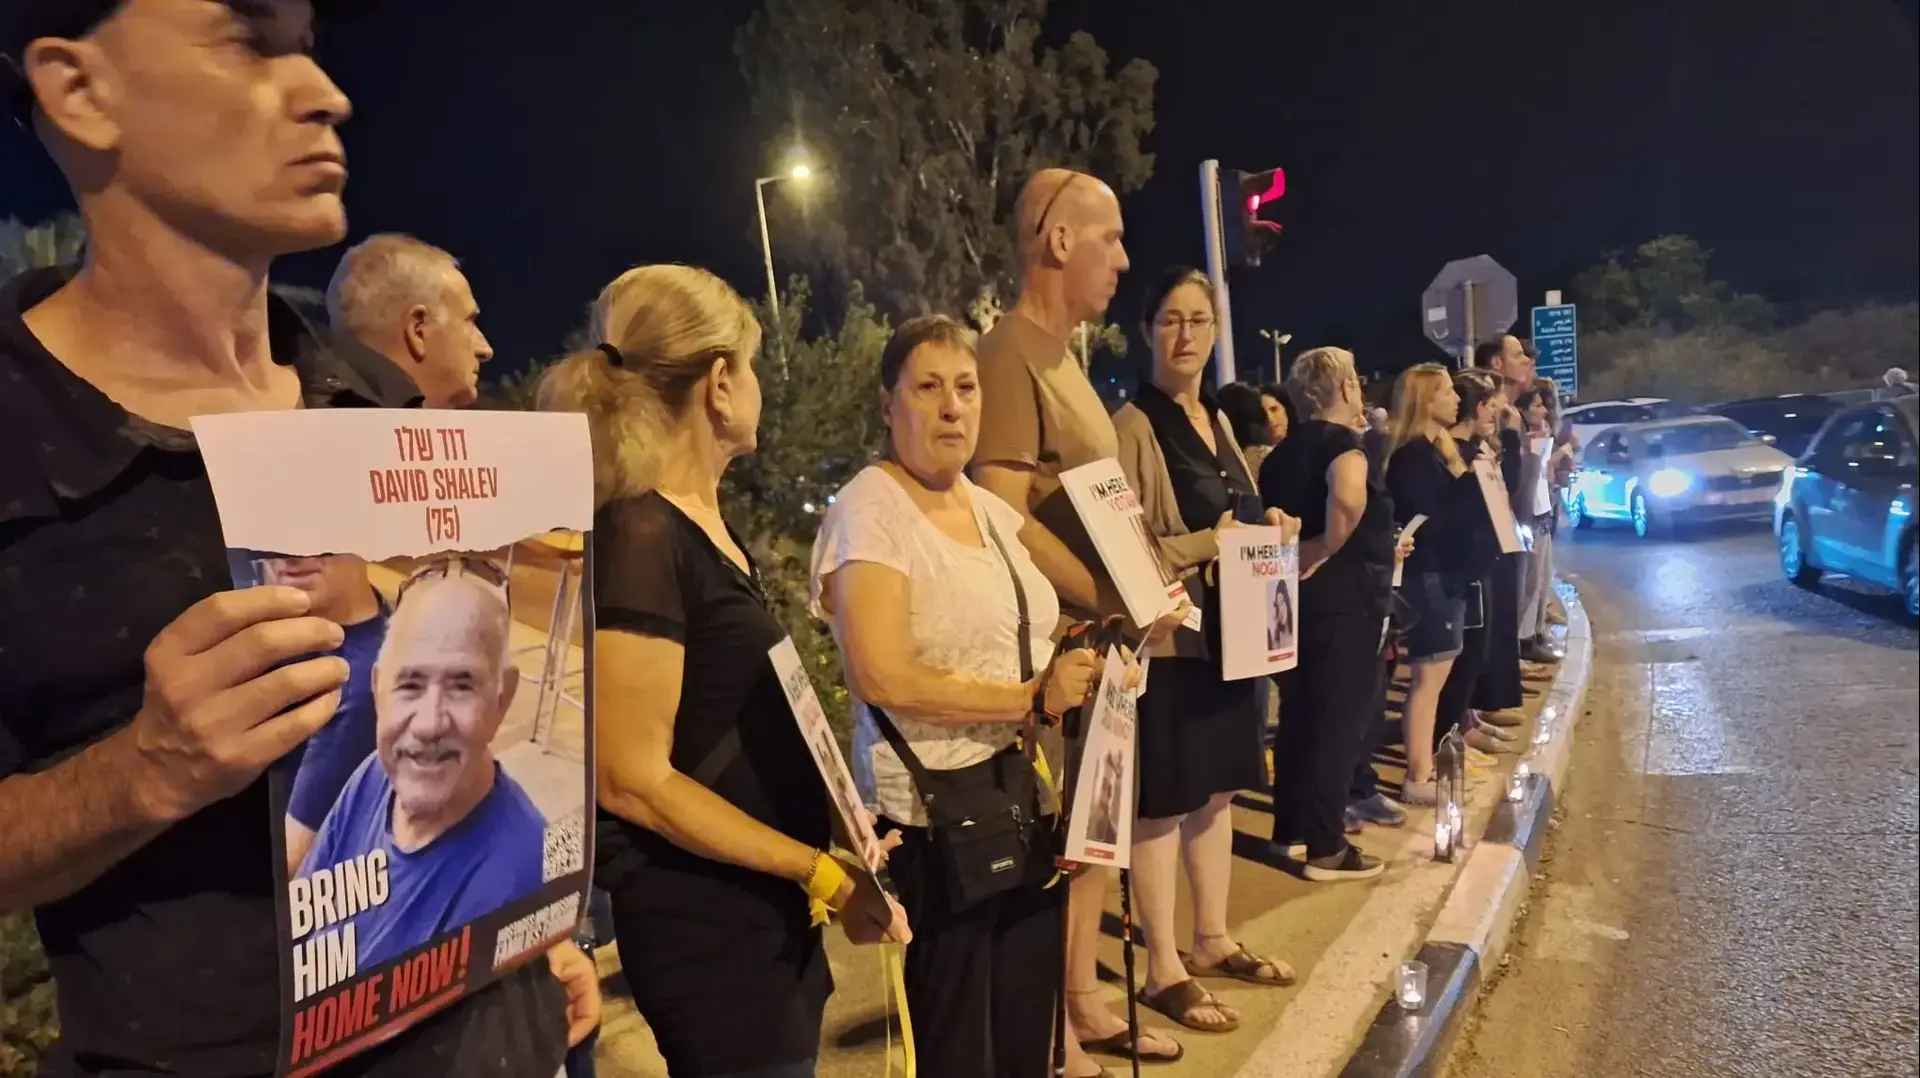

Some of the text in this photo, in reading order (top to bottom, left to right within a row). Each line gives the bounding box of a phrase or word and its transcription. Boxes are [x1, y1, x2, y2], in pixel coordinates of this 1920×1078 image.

[394, 426, 467, 462] דוד שלו
[369, 467, 498, 505] DAVID SHALEV
[425, 505, 461, 545] (75)
[1240, 545, 1256, 561] I'M
[289, 847, 390, 940] BRING
[293, 921, 356, 1003] HIM
[290, 973, 384, 1066] HOME
[389, 924, 471, 1014] NOW!
